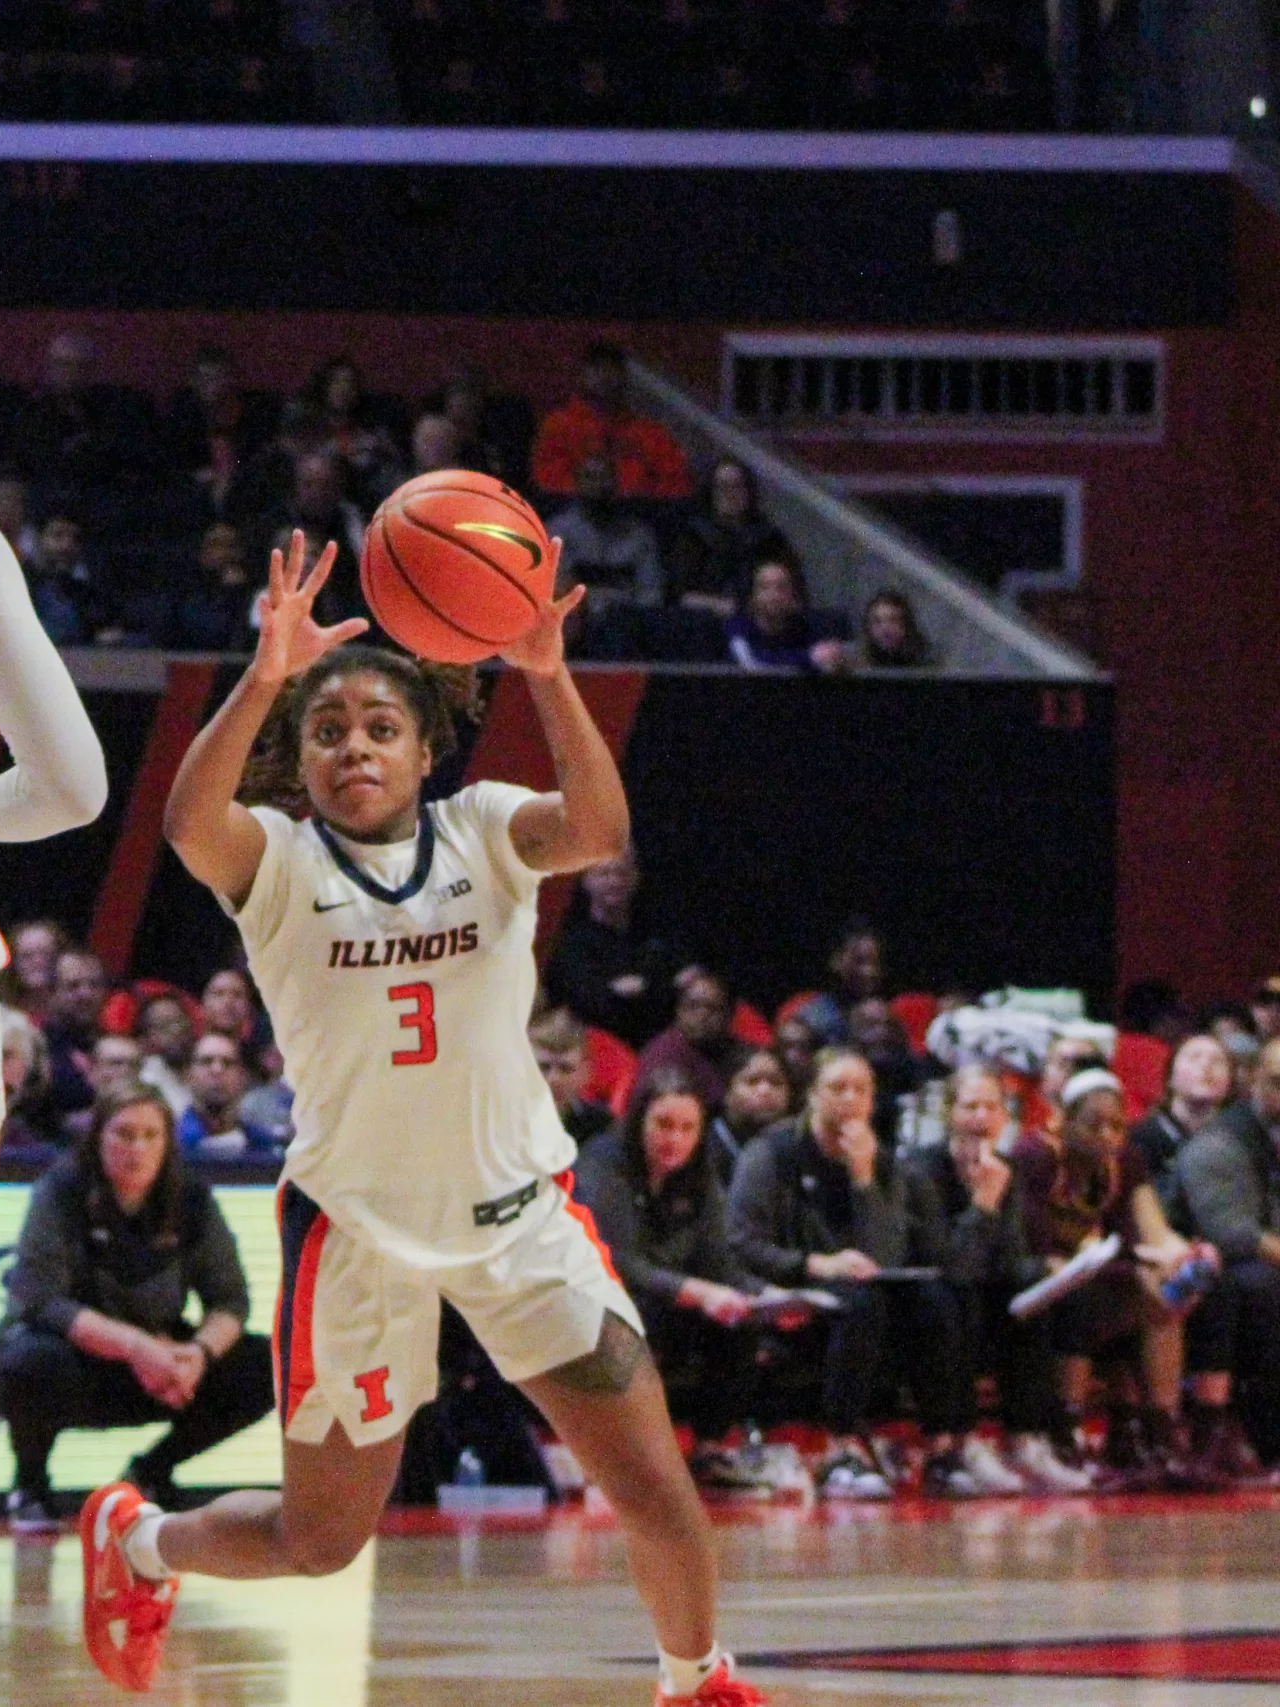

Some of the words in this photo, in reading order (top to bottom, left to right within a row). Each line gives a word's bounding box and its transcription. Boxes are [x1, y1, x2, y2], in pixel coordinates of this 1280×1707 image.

[327, 921, 479, 969] ILLINOIS
[387, 980, 438, 1067] 3
[353, 1364, 394, 1425] I
